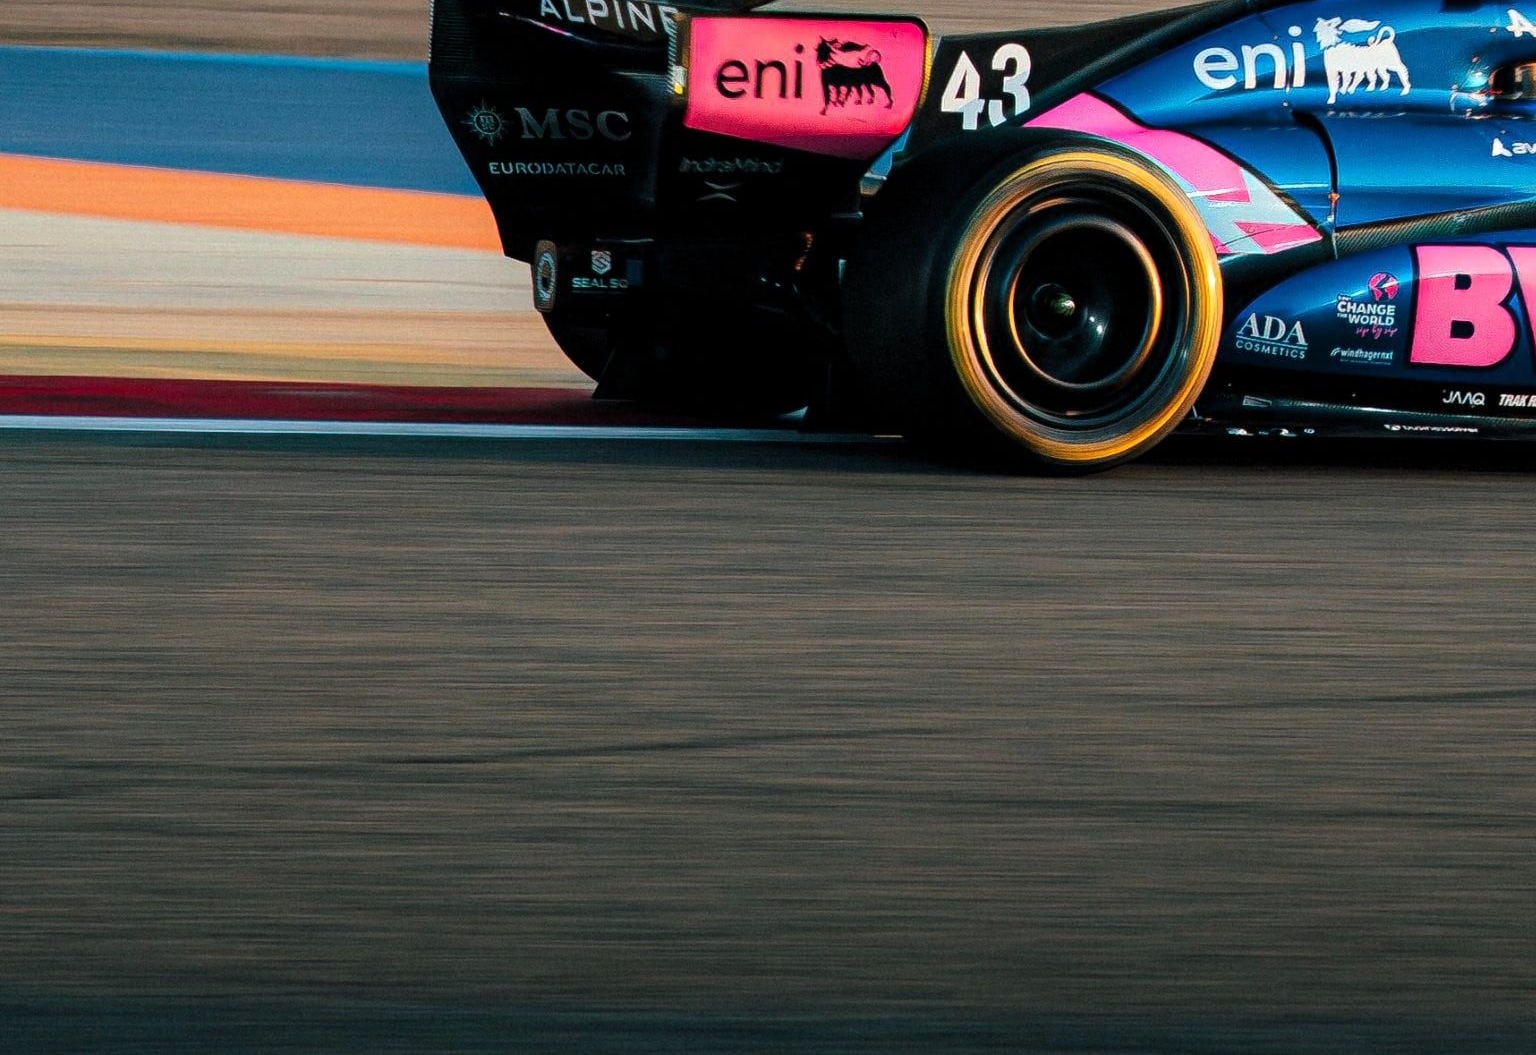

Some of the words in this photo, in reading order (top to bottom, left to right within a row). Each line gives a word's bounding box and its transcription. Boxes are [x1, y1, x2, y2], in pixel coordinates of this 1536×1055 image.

[716, 43, 804, 99] eni
[1192, 26, 1305, 91] eni
[941, 42, 1032, 131] 43
[514, 107, 632, 141] MSC
[488, 162, 627, 176] EURODATACAR
[1337, 301, 1397, 316] CHANGE
[1348, 313, 1395, 326] WORLD
[1237, 312, 1309, 346] ADA
[1236, 339, 1306, 359] COSMETICS
[1499, 394, 1527, 407] TRAK
